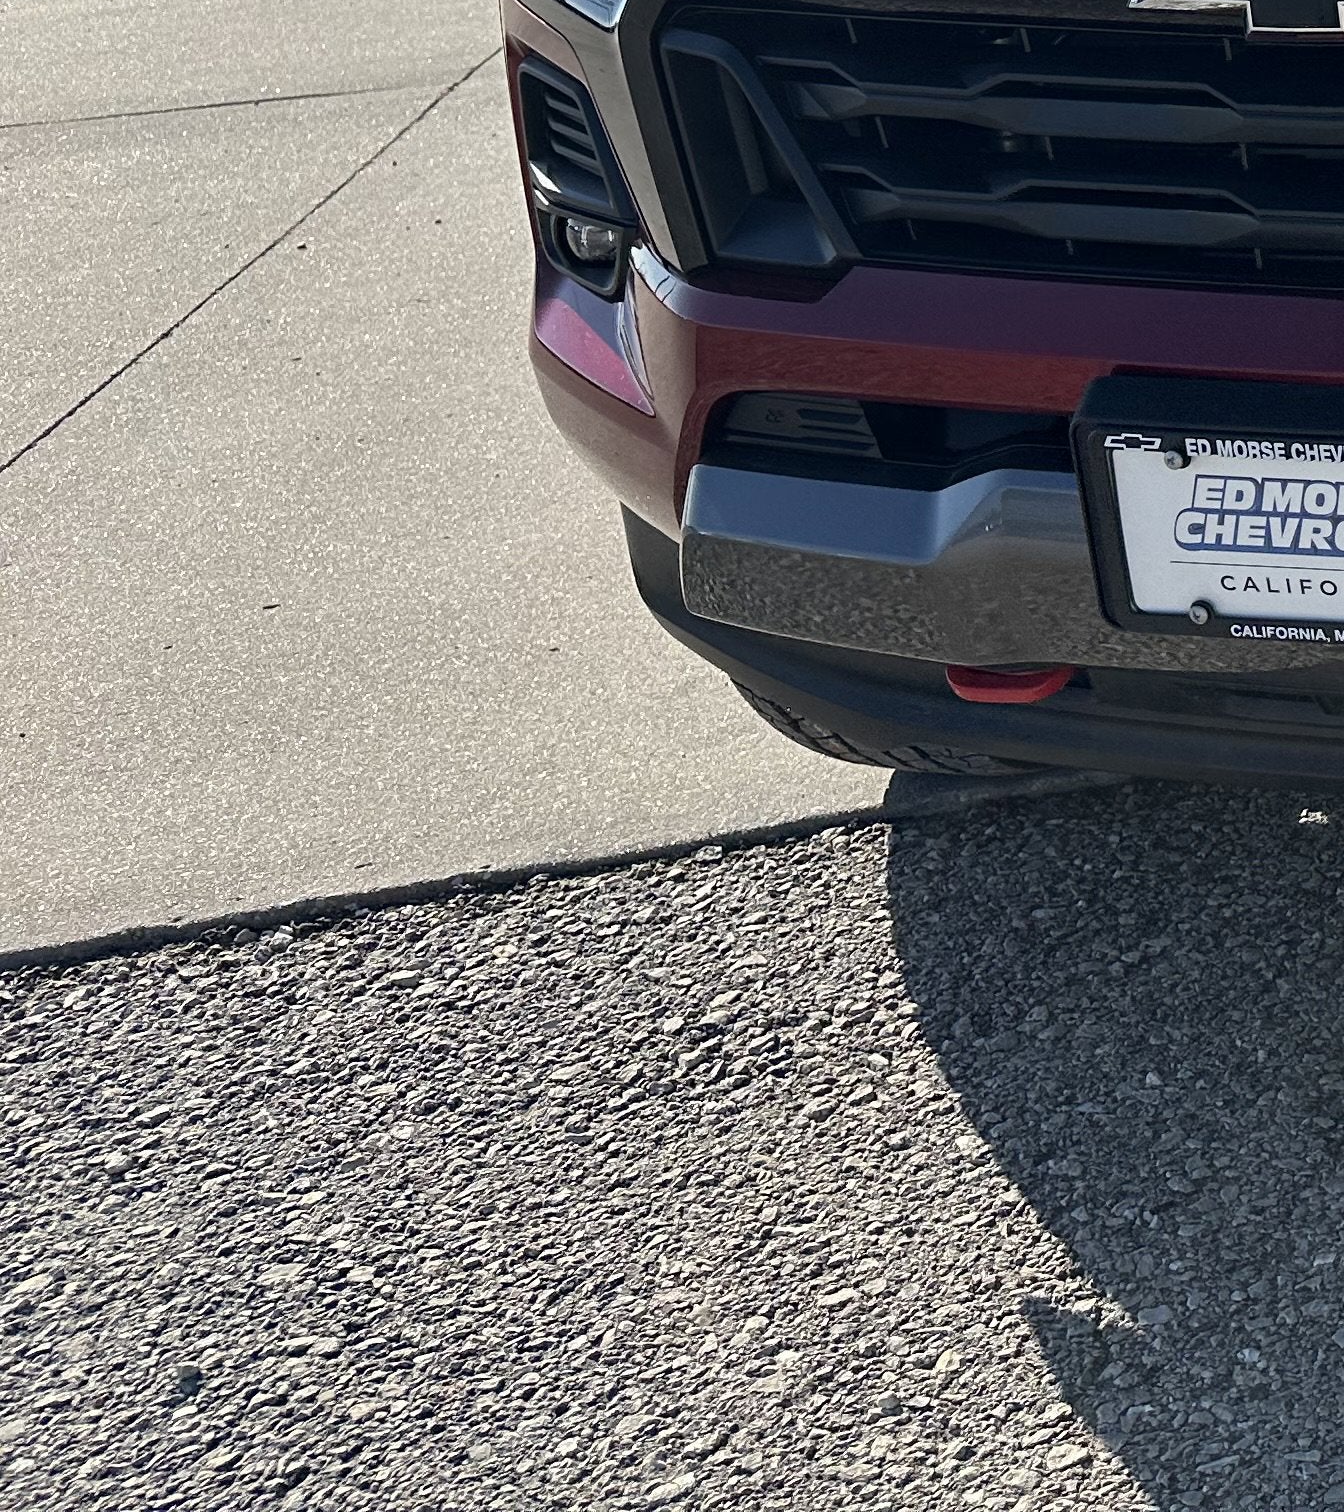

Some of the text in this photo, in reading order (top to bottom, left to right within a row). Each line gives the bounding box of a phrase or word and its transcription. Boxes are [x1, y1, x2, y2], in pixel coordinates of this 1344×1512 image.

[1184, 438, 1212, 458] ED
[1215, 439, 1287, 461] MORSE
[1192, 474, 1258, 511] ED
[1230, 624, 1331, 643] CALIFORNIA,
